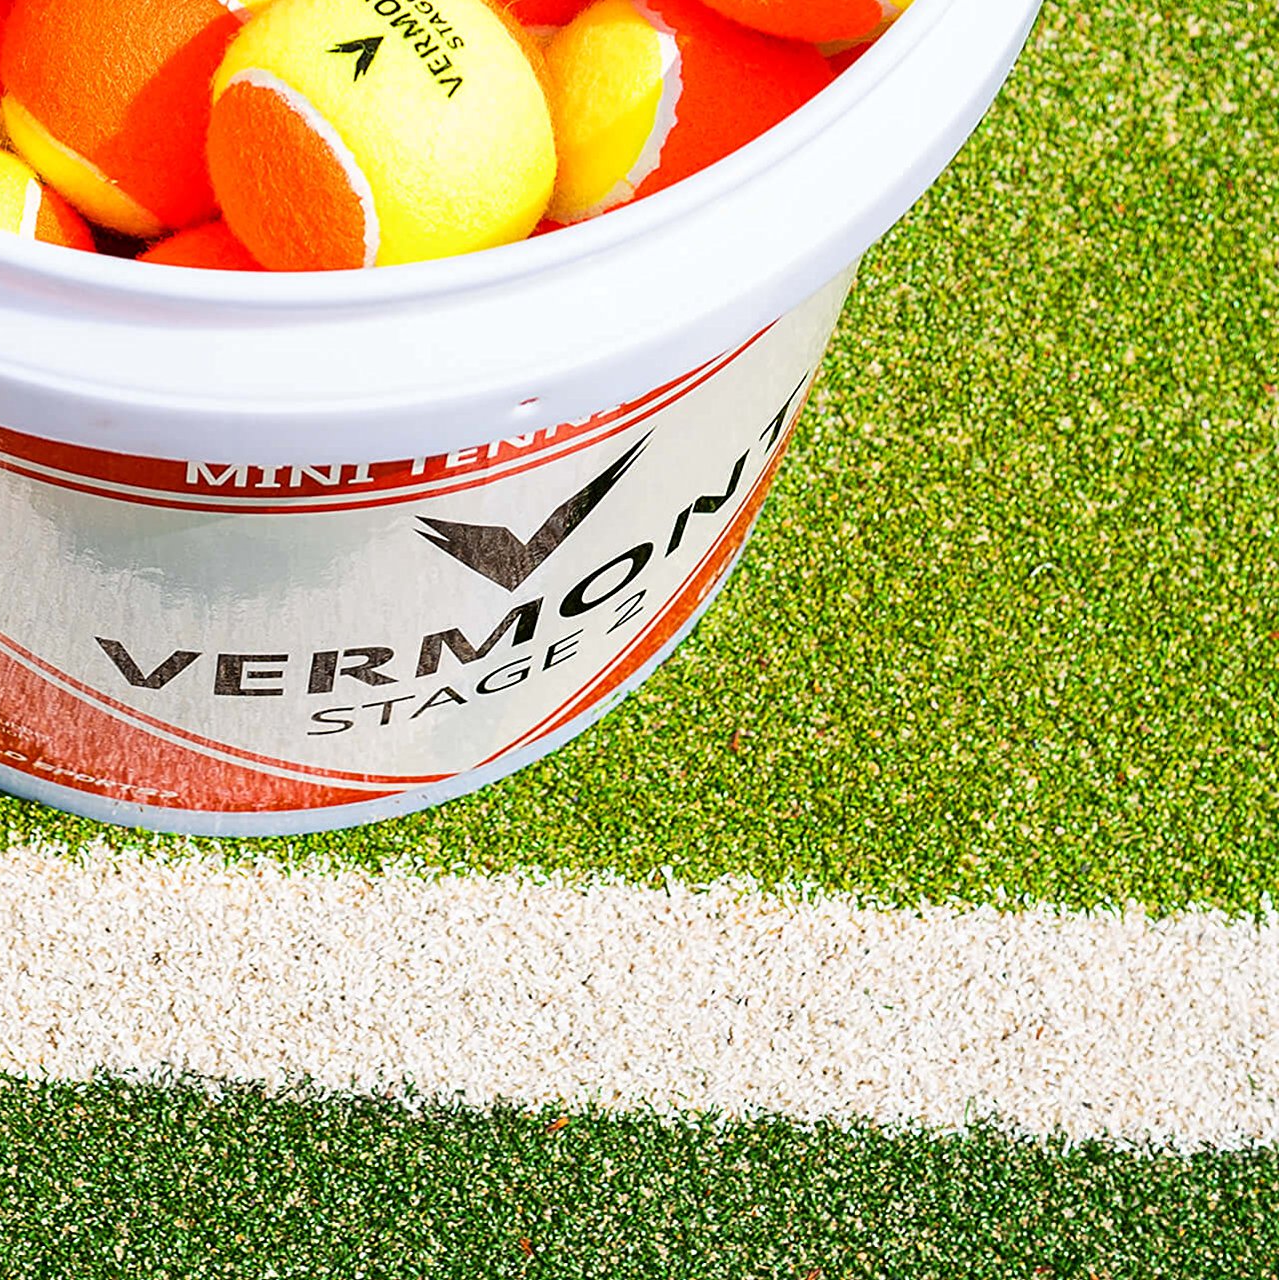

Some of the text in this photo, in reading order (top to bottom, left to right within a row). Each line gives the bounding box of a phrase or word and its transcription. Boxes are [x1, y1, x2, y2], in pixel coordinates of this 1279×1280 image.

[94, 370, 809, 696] VERMONT
[186, 461, 374, 488] MINI
[307, 589, 647, 736] STAGE 2
